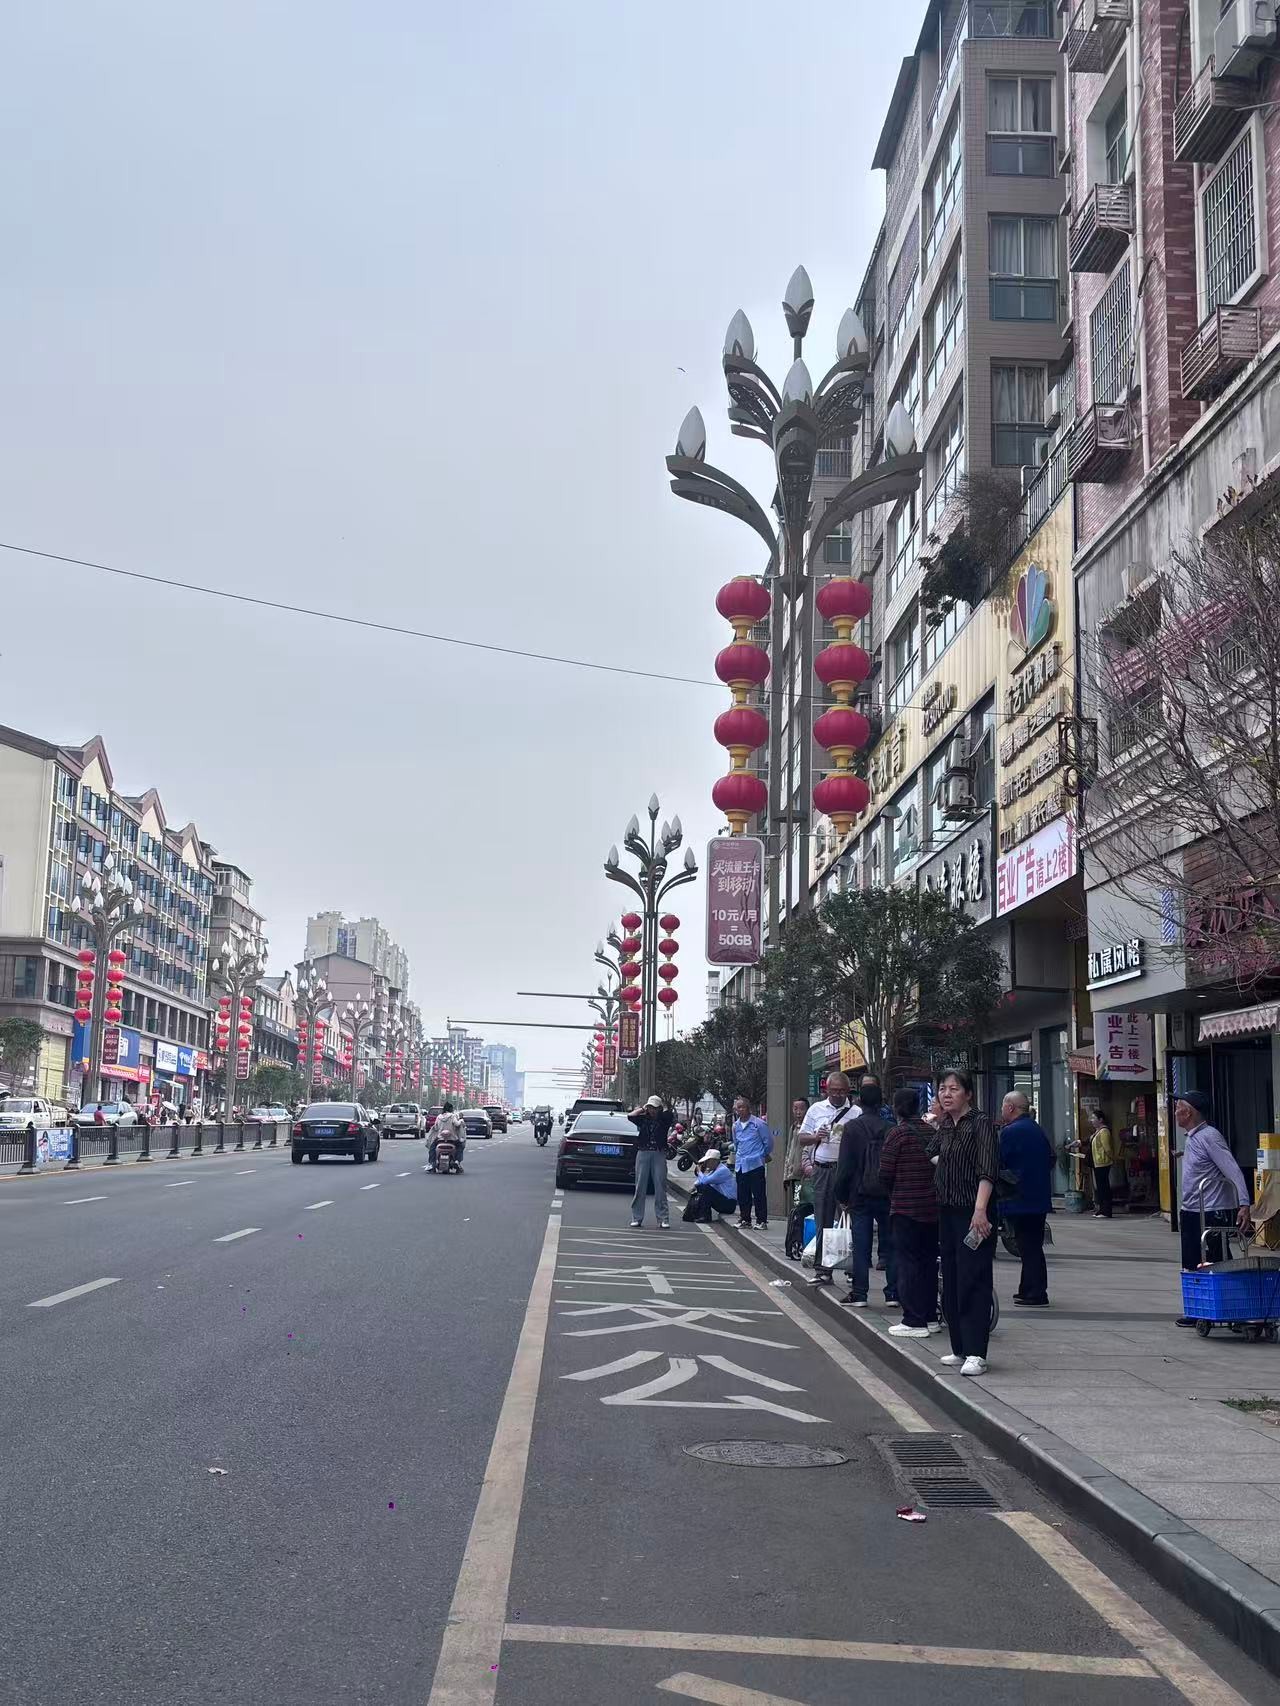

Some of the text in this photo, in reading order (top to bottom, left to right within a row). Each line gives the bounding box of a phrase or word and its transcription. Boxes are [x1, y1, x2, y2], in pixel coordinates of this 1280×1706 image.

[711, 861, 760, 877] 买流量王卡
[718, 876, 756, 896] 到移动
[712, 909, 758, 922] 10元/月
[718, 934, 752, 946] 50GB
[1088, 938, 1140, 979] 私属风格
